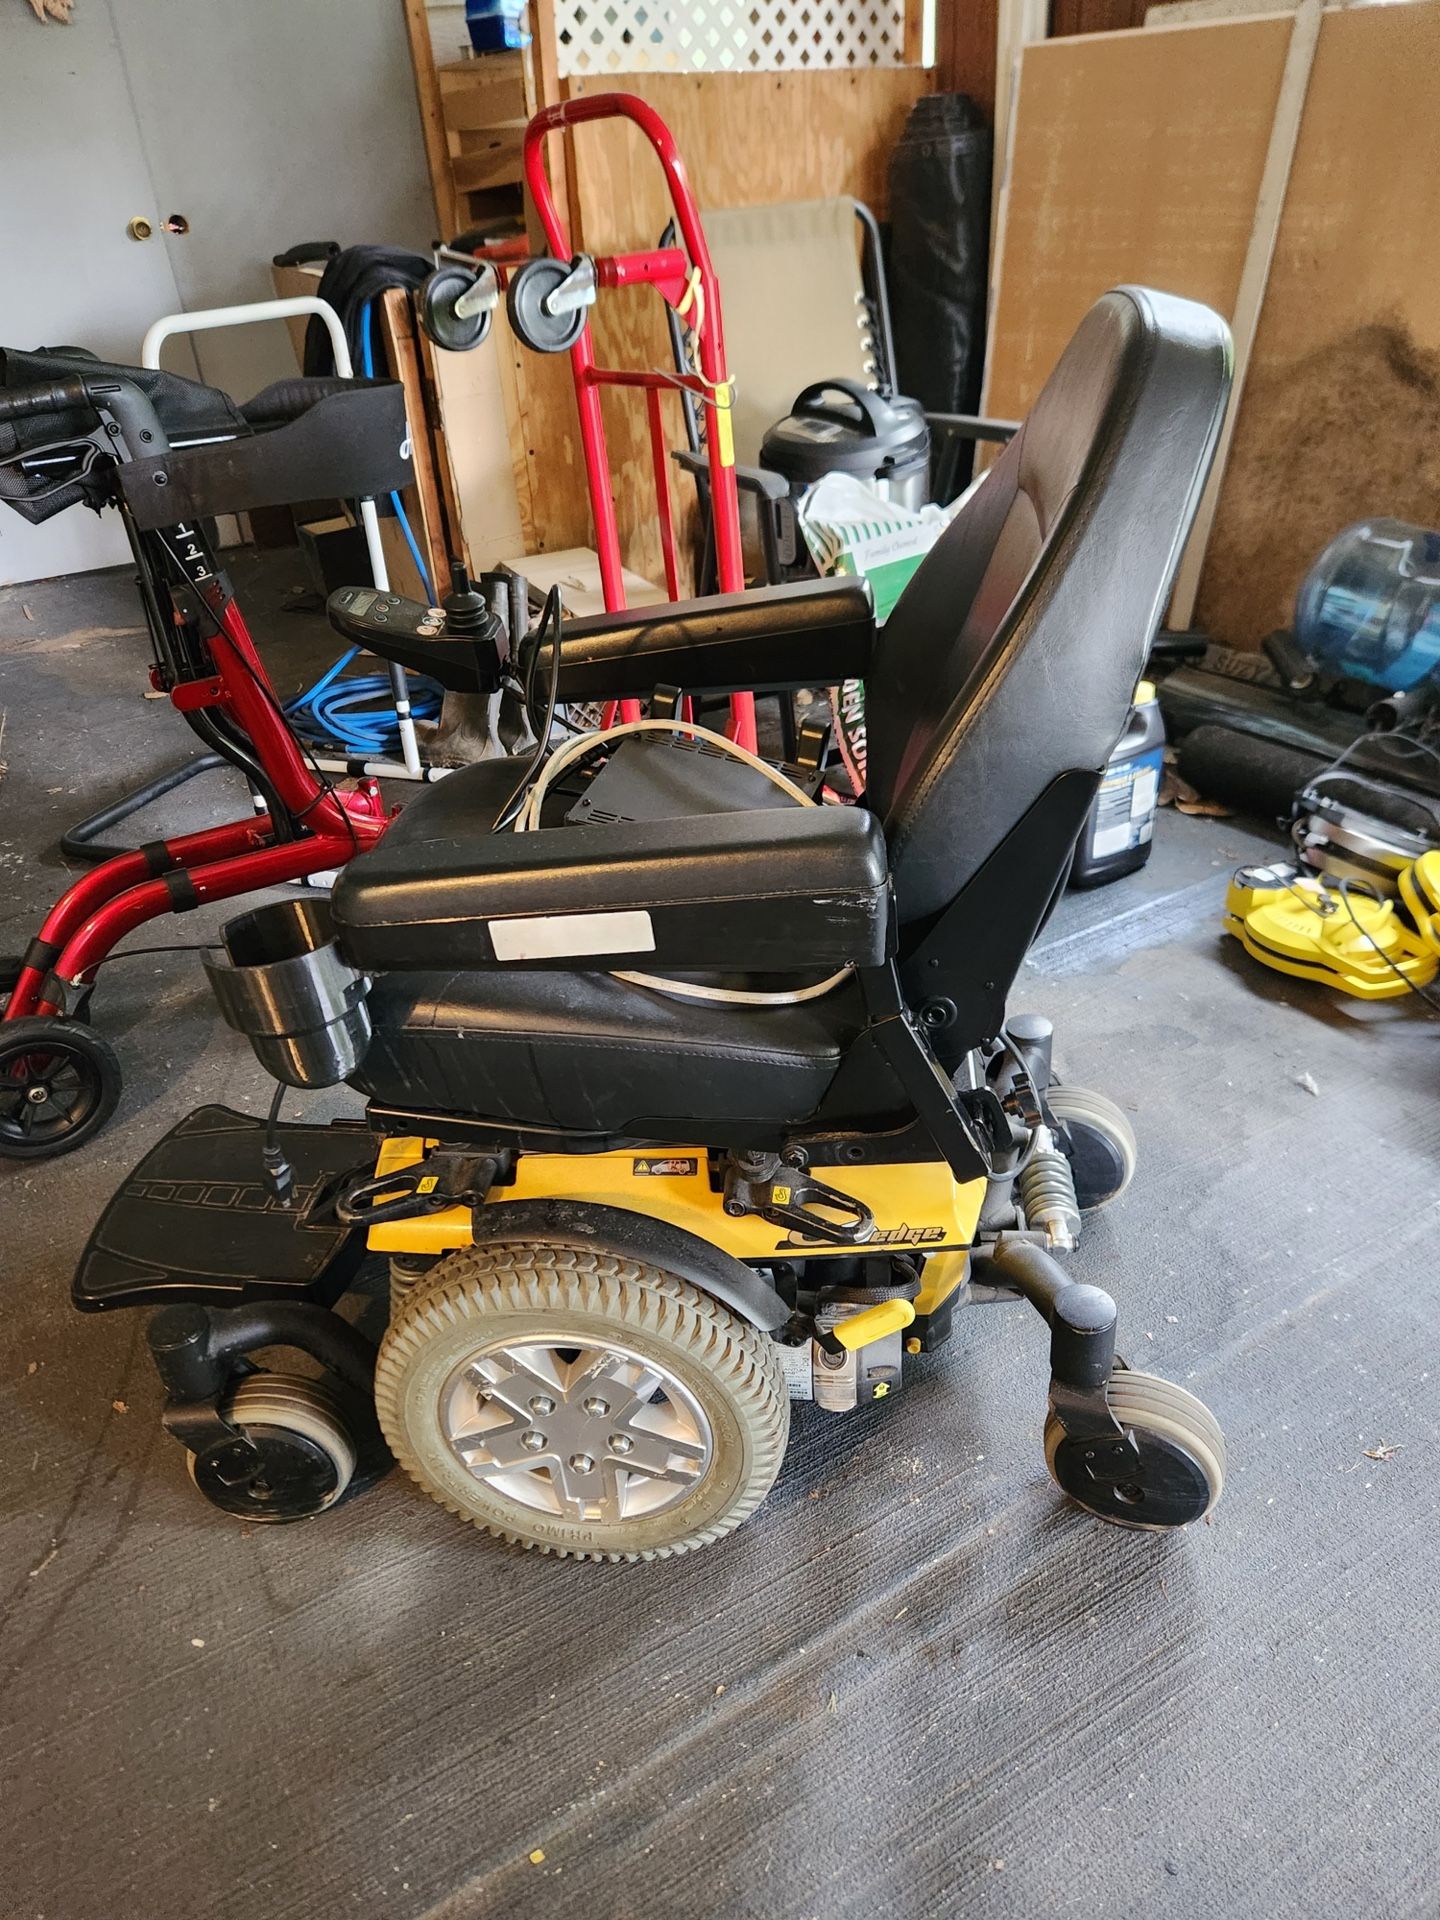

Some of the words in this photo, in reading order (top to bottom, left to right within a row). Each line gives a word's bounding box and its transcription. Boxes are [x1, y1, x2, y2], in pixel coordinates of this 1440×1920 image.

[178, 522, 187, 533] 1
[187, 543, 198, 555] 2
[196, 565, 206, 577] 3
[869, 1222, 942, 1246] edge
[532, 1522, 593, 1541] PRIMO
